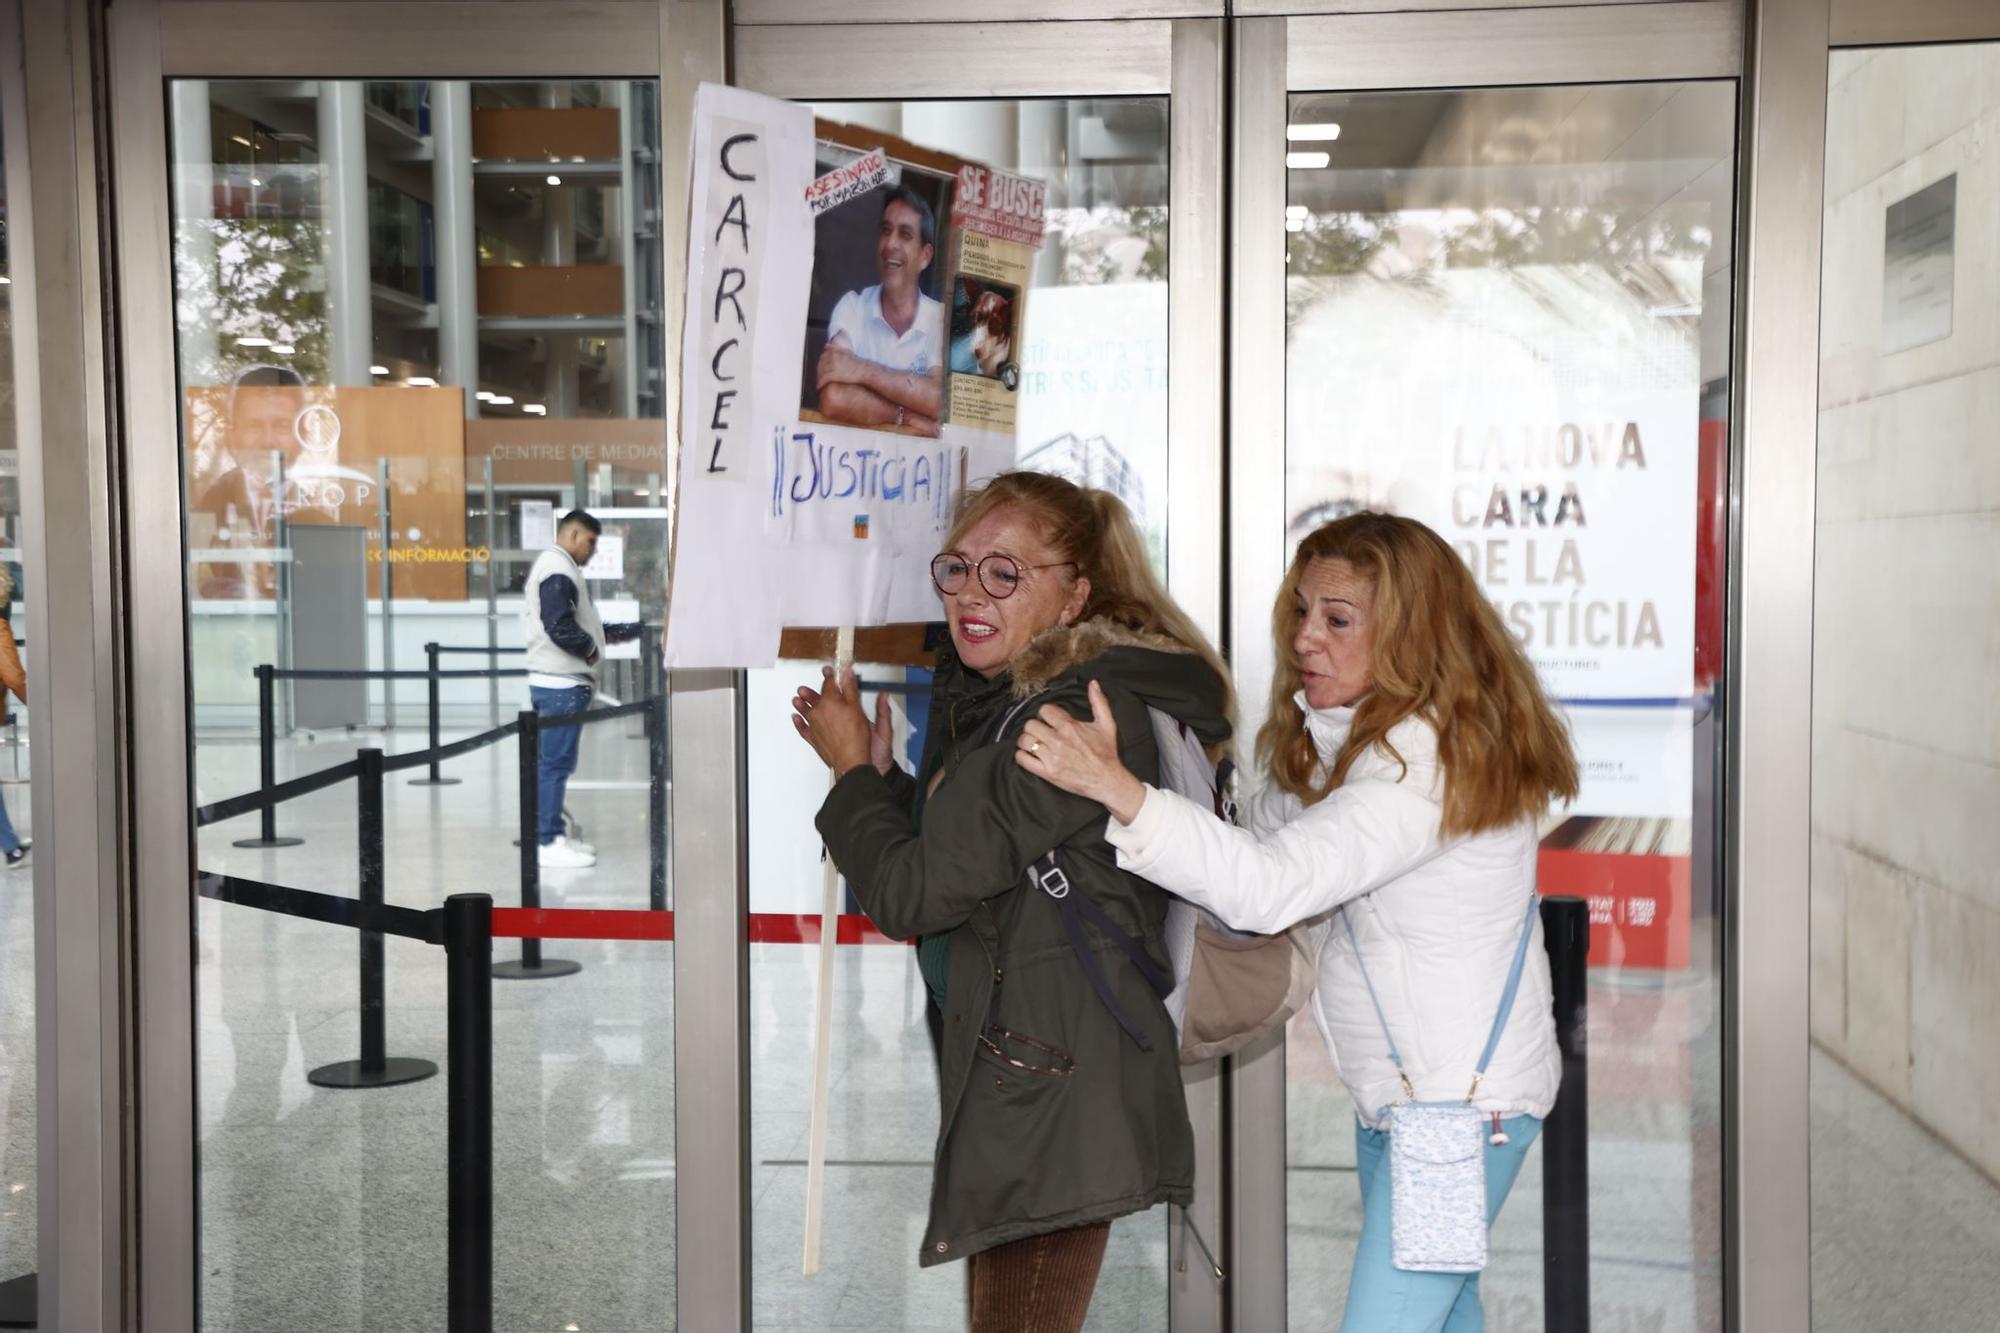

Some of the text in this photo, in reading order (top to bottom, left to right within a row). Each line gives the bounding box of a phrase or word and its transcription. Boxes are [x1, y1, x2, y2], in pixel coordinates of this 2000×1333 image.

[803, 154, 881, 201] ASESINADO
[960, 164, 986, 206] SE
[990, 172, 1044, 220] BUSC
[707, 133, 758, 473] CARCEL
[492, 443, 566, 460] CENTRE
[571, 443, 595, 460] DE
[1453, 421, 1647, 471] LA NOVA
[1451, 481, 1587, 529] CARA
[388, 545, 490, 564] INFORMACIÓ
[1525, 539, 1586, 586] LA
[1497, 589, 1665, 649] STÍCIA
